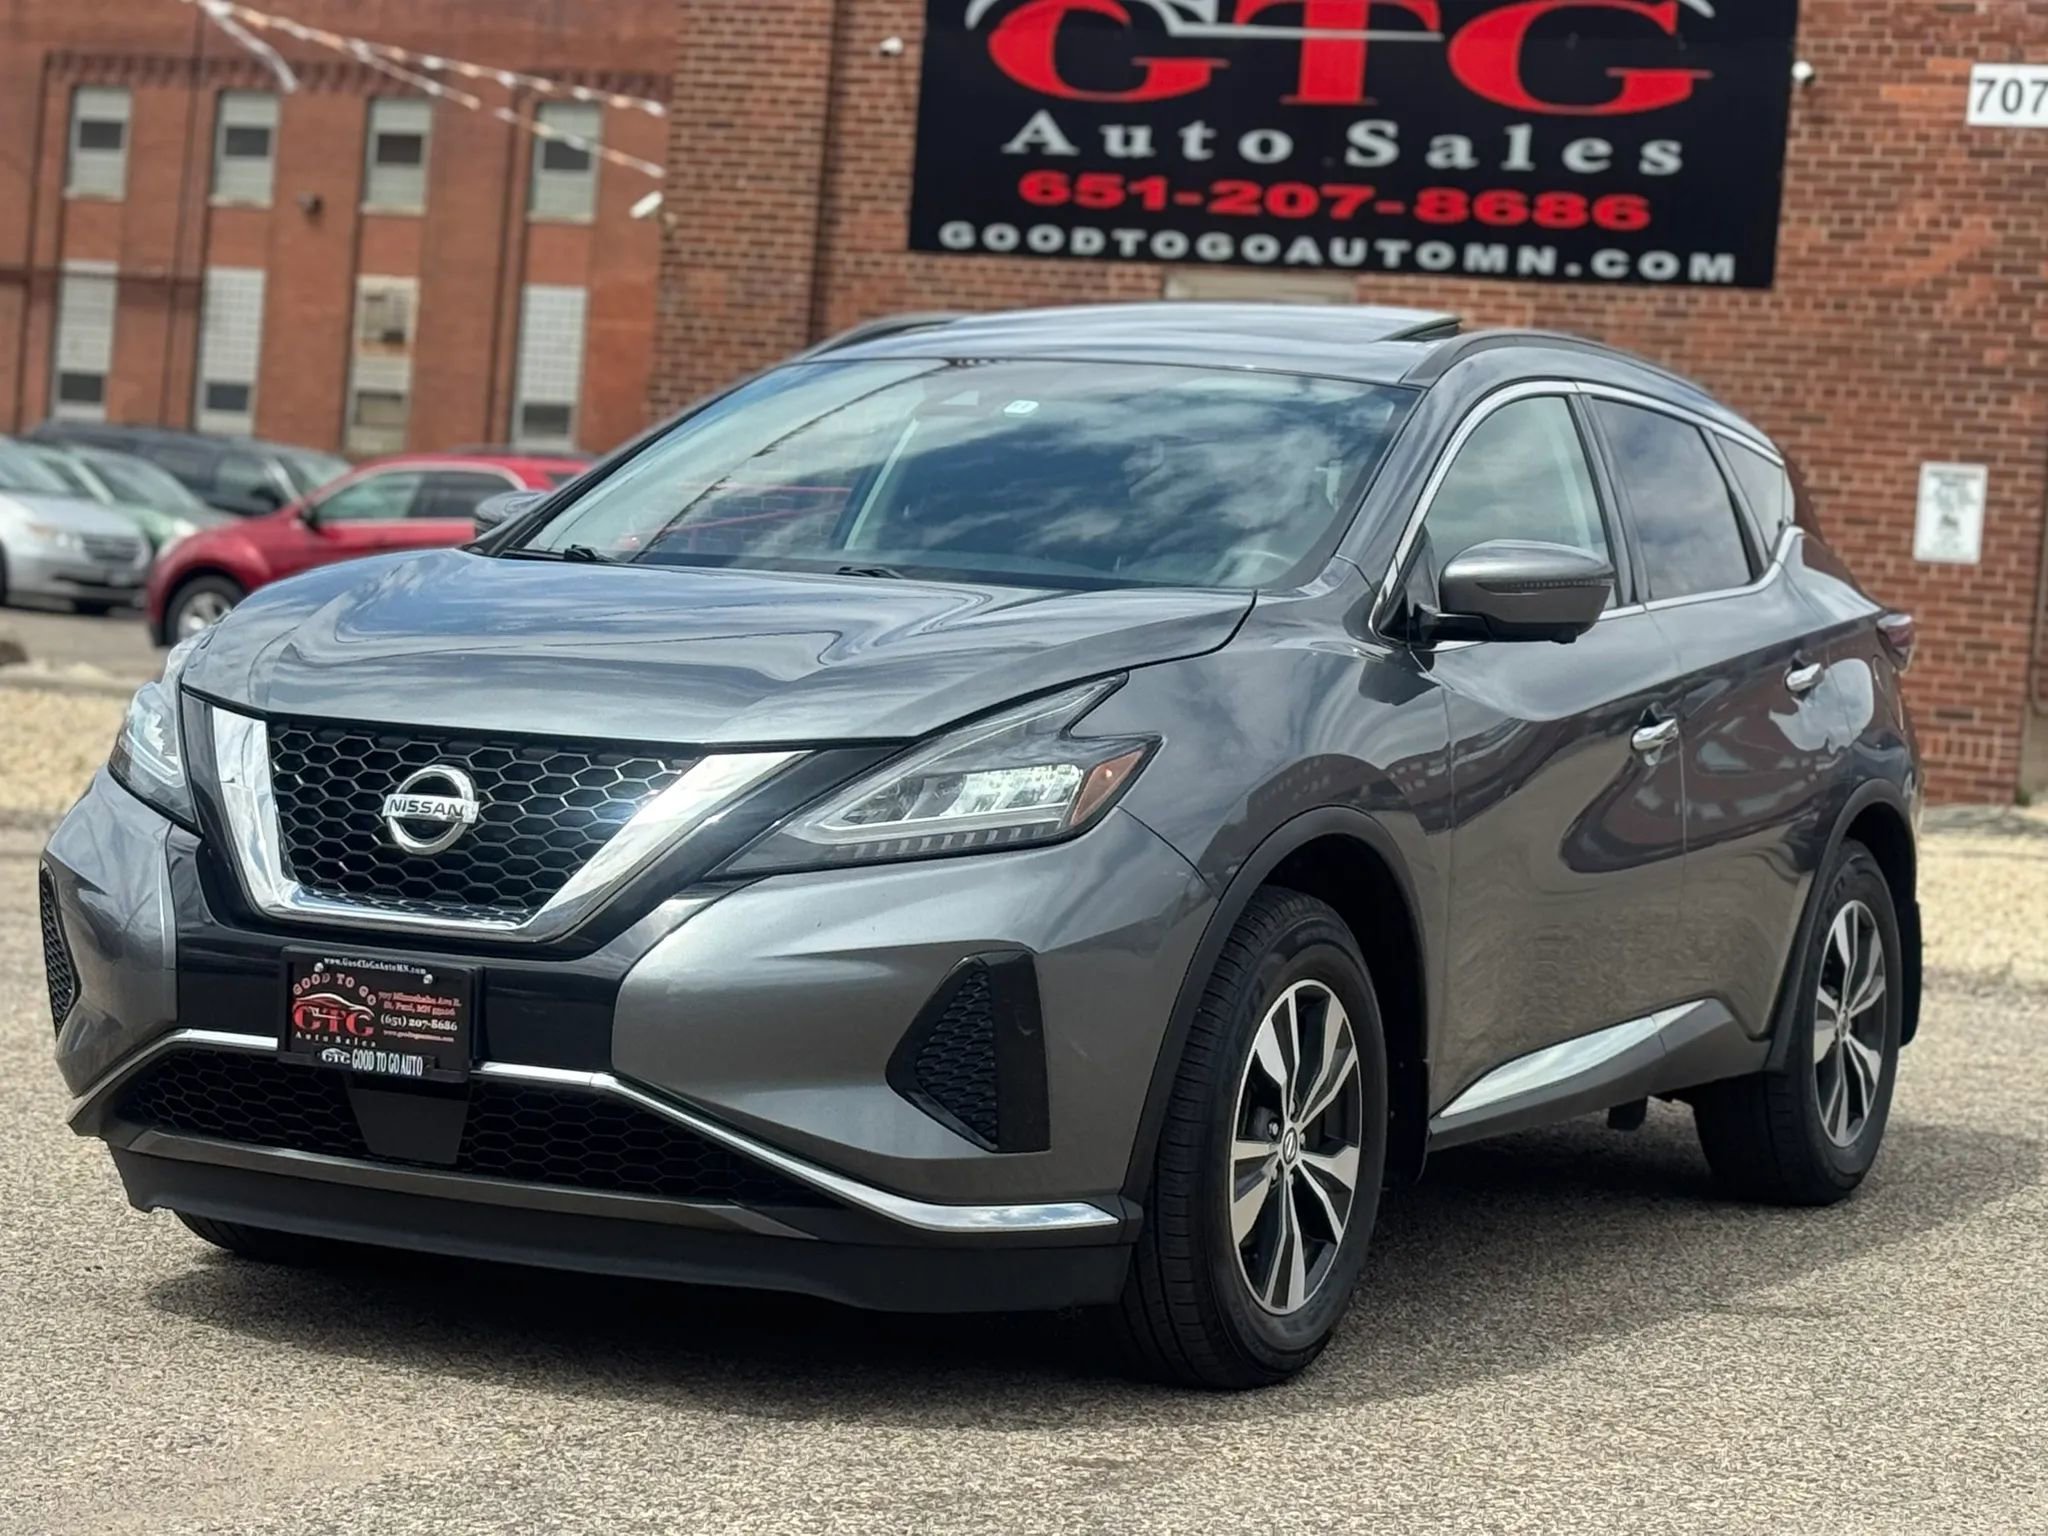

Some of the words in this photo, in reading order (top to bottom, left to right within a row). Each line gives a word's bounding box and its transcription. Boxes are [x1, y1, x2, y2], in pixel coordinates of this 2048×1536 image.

[988, 0, 1714, 116] GTG
[1976, 78, 2048, 114] 707
[1001, 109, 1293, 164] Auto
[1346, 119, 1683, 175] Sales
[1018, 170, 1651, 230] 651-207-8686
[938, 221, 1736, 283] GOODTOGOAUTOMN.COM
[389, 798, 464, 817] NISSAN
[293, 972, 331, 996] GOOD
[336, 973, 355, 988] TO
[359, 986, 376, 1006] GO
[293, 1005, 375, 1037] GTG
[380, 1013, 407, 1027] (651)
[408, 1018, 458, 1031] 207-8686
[295, 1031, 329, 1043] Auto
[336, 1034, 376, 1047] Sales
[322, 1051, 351, 1064] GTG
[352, 1048, 375, 1071] GOOD
[376, 1051, 387, 1073] TO
[388, 1053, 400, 1074] GO
[401, 1055, 423, 1077] AUTO
